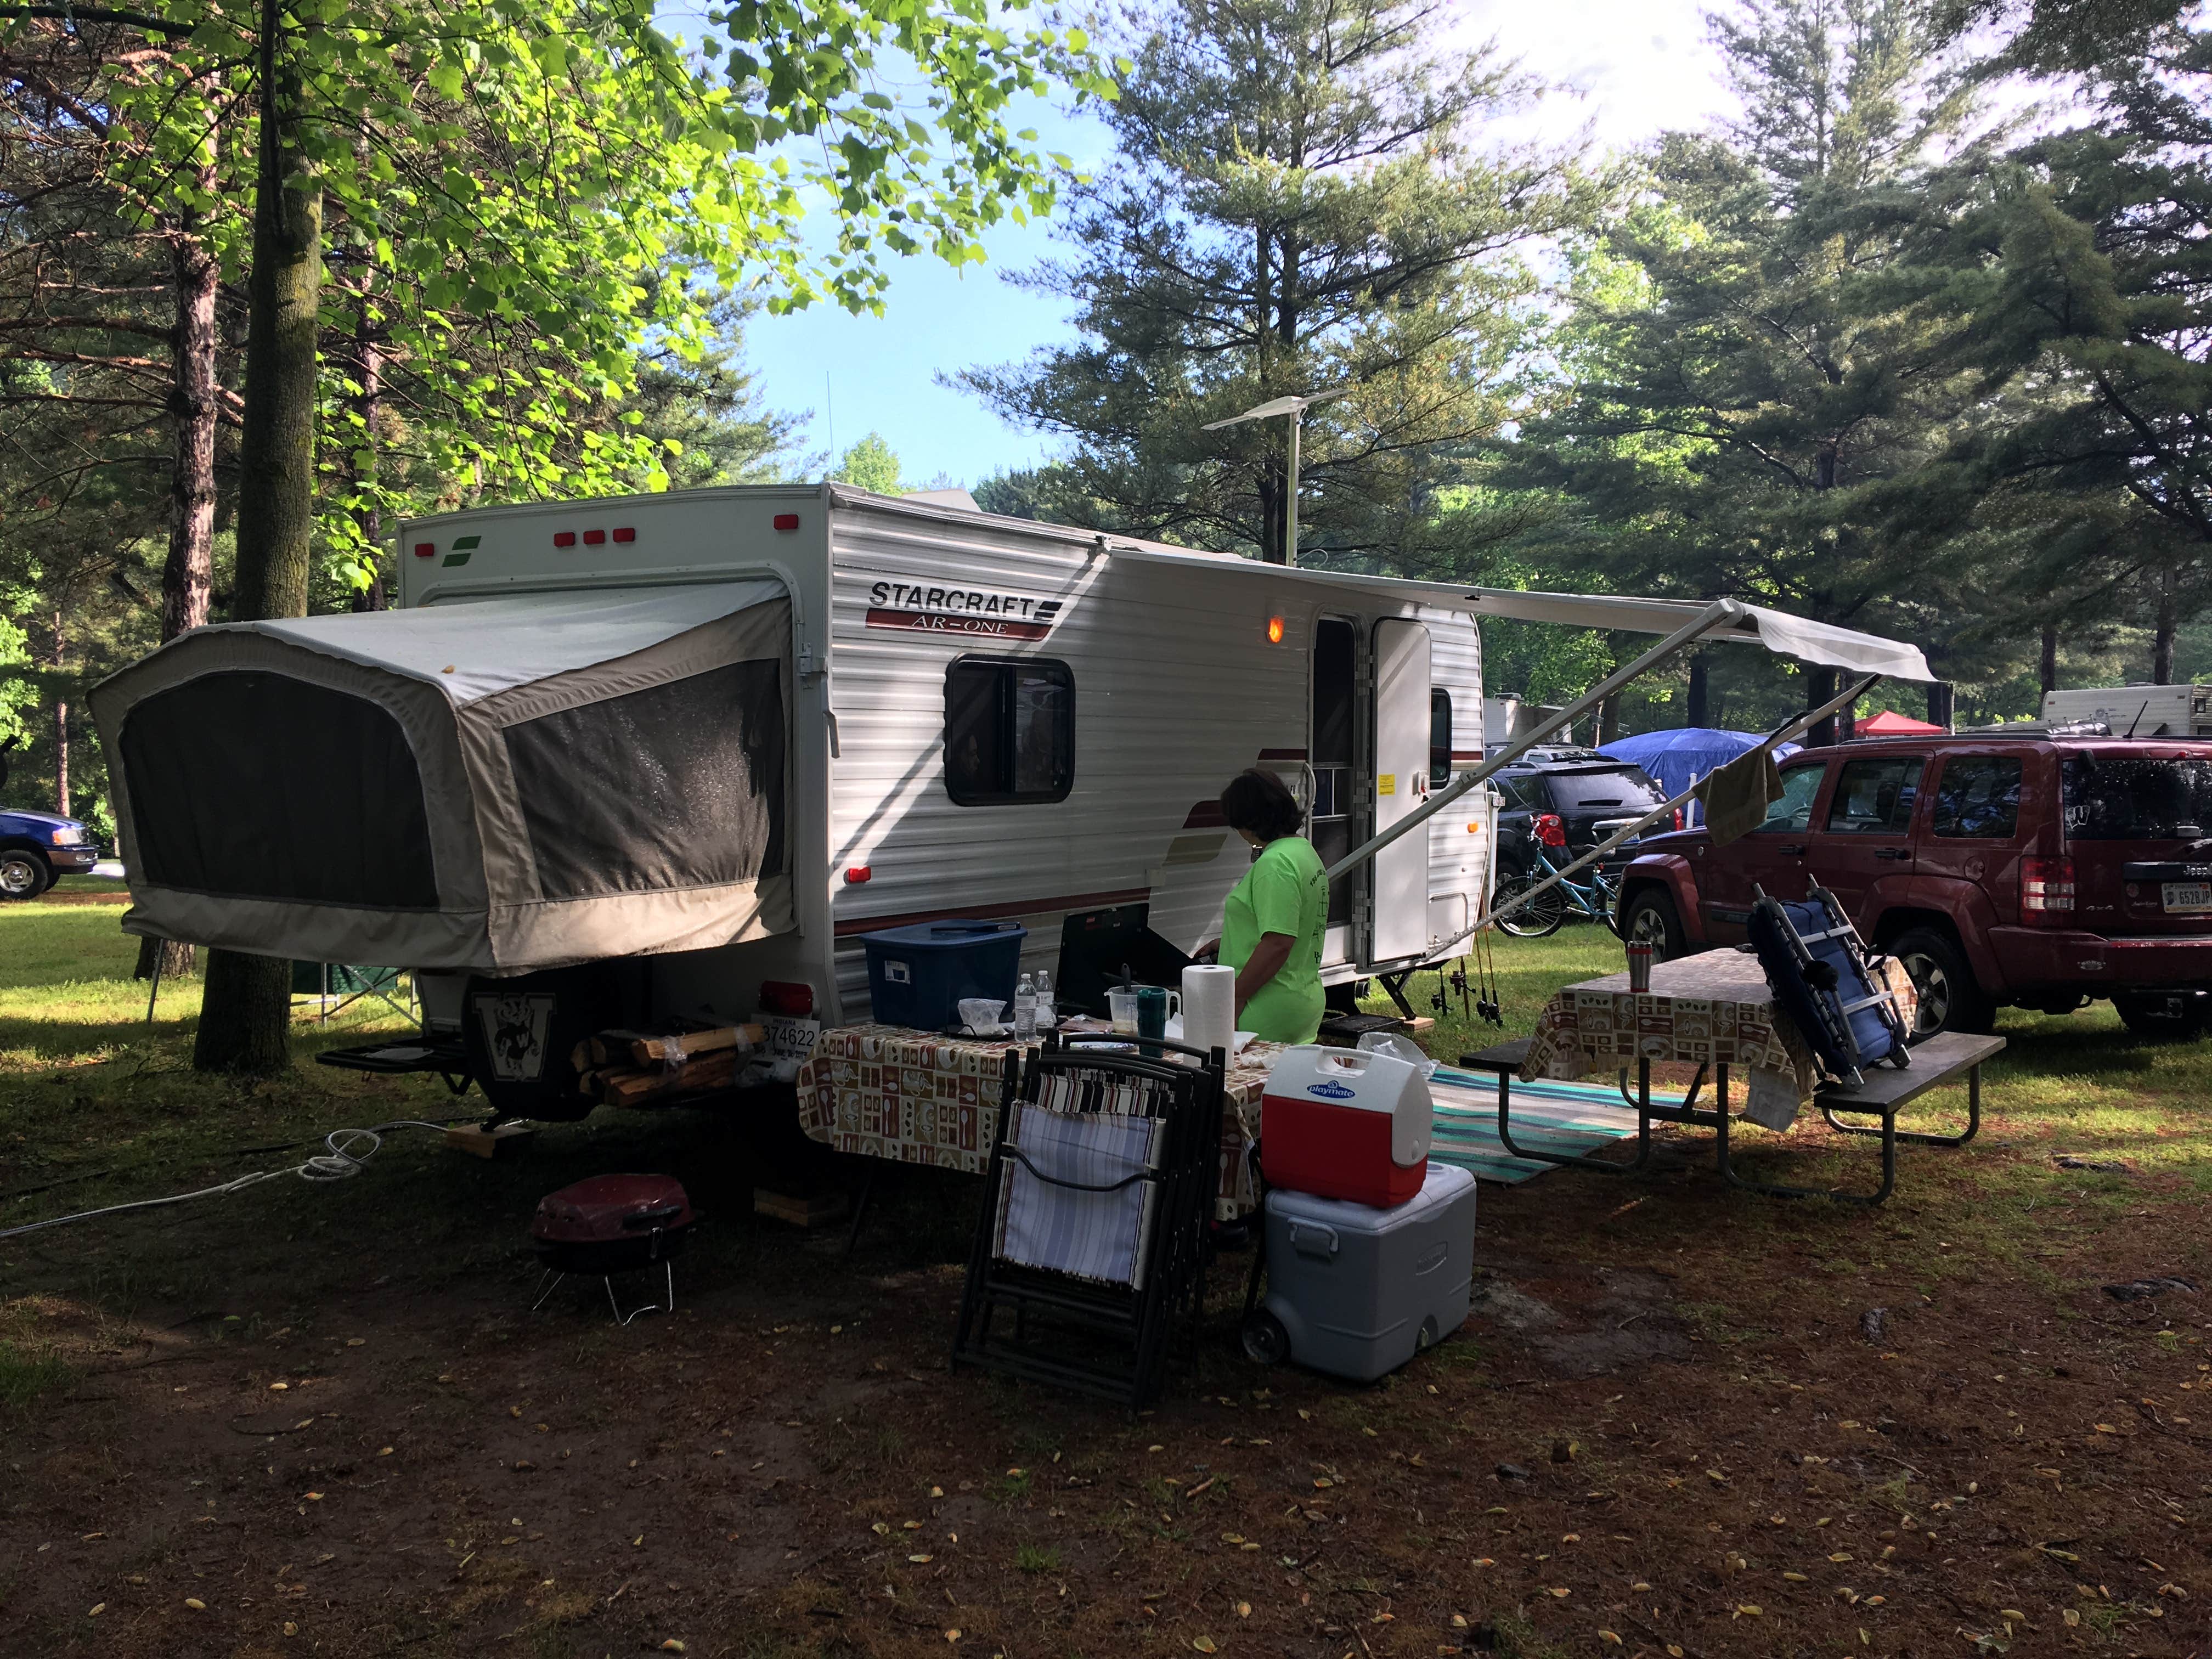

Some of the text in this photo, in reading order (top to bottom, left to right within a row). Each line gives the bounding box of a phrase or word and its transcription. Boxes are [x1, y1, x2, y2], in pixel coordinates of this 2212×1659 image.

[869, 582, 1035, 619] STARCRAFT
[911, 615, 1008, 634] AR-ONE
[1309, 1086, 1353, 1097] playmate
